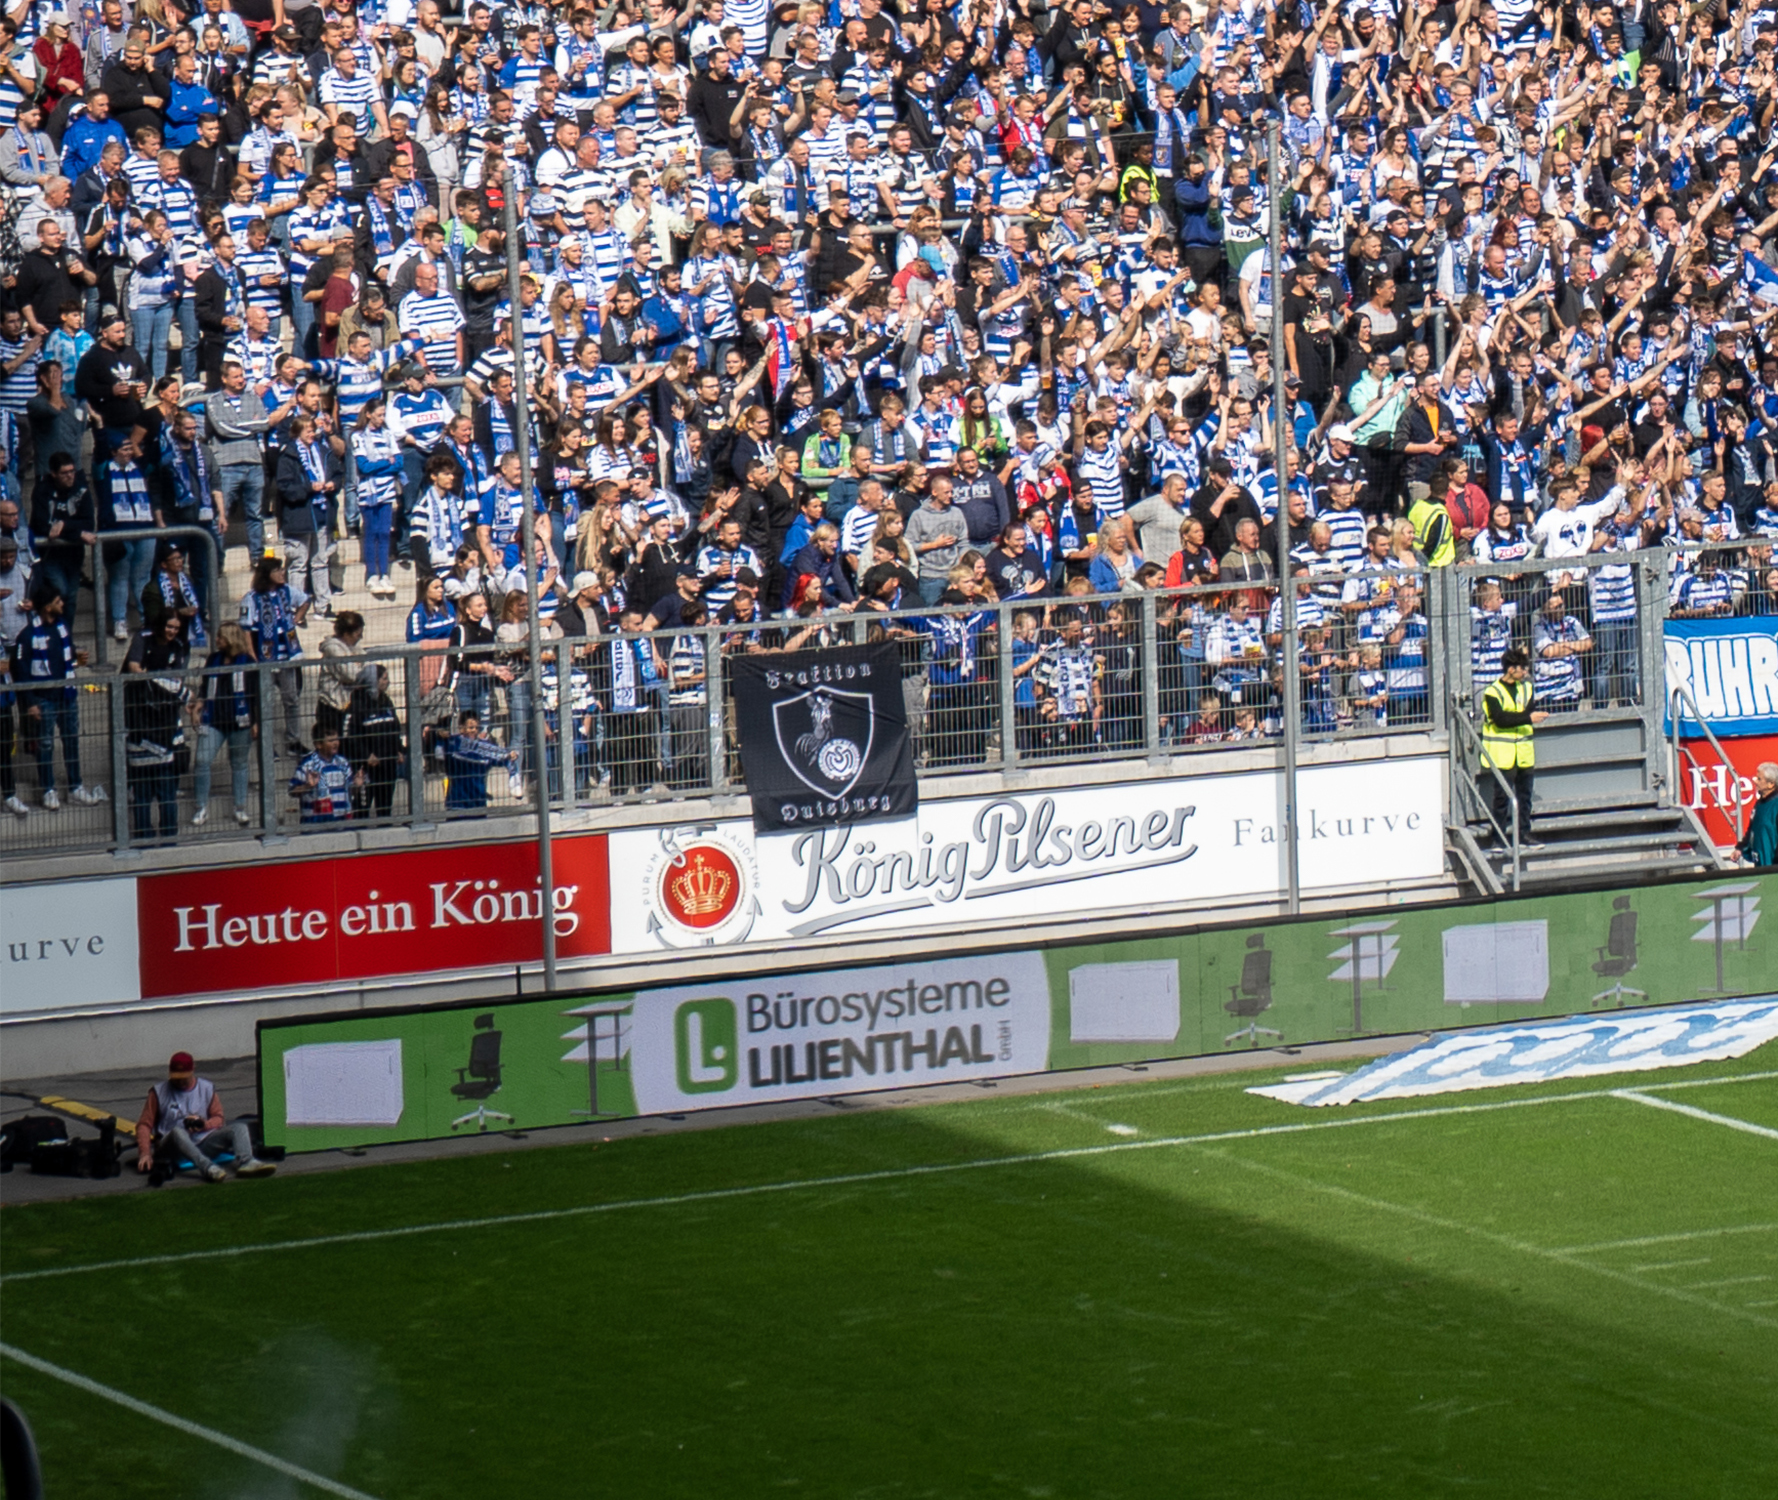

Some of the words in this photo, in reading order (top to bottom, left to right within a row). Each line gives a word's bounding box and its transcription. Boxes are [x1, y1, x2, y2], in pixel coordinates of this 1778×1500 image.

[781, 825, 969, 912] König
[960, 795, 1199, 886] Pilsener
[173, 902, 328, 954] Heute
[340, 889, 417, 934] ein
[428, 875, 579, 937] König
[748, 974, 1011, 1033] Bürosysteme
[749, 1023, 994, 1089] LILIENTHAL
